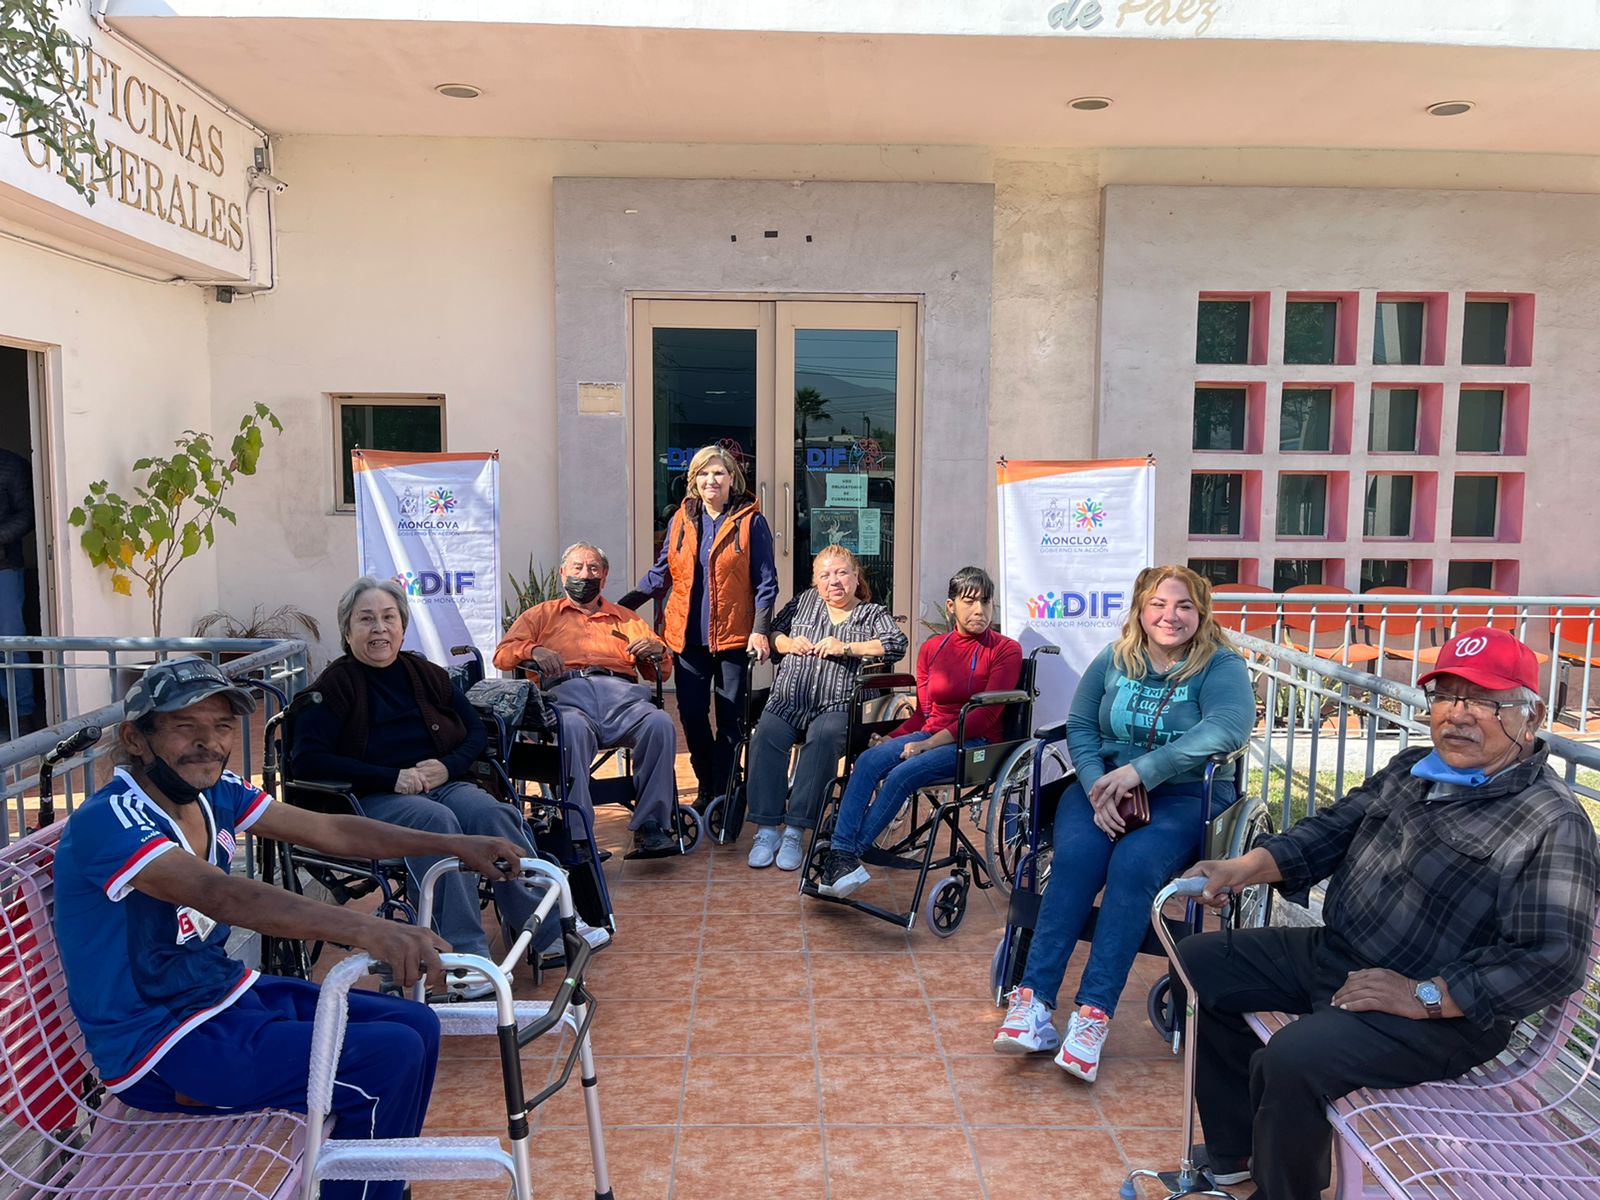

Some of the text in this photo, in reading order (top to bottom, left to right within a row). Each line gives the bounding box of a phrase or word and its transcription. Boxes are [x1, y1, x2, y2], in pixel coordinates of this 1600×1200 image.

[1047, 0, 1104, 31] de
[53, 28, 225, 178] OFICINAS
[807, 447, 848, 468] DIF
[398, 521, 460, 529] MONCLOVA
[1041, 536, 1108, 545] MONCLOVA
[419, 571, 475, 596] DIF
[1061, 591, 1124, 619] DIF
[1455, 636, 1488, 657] W
